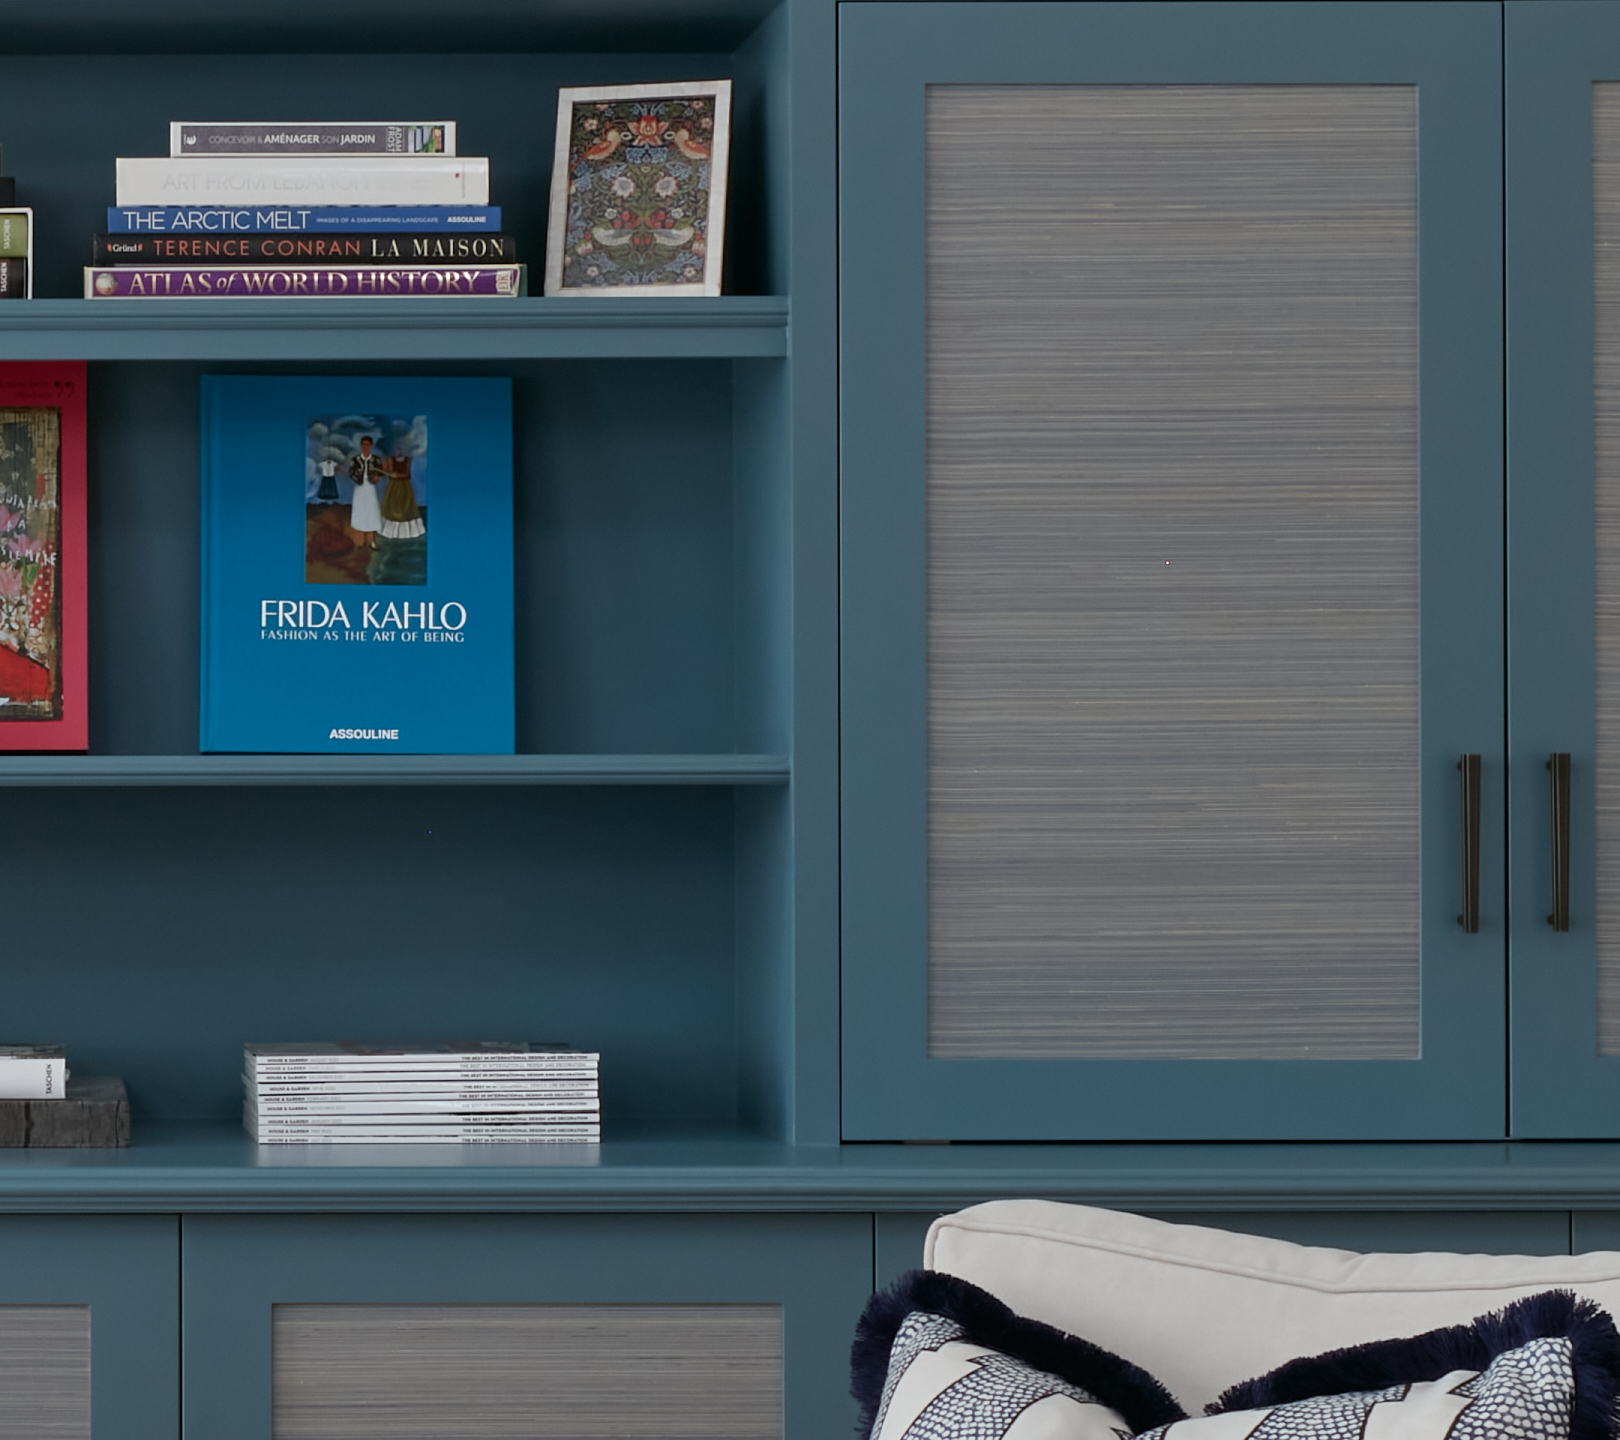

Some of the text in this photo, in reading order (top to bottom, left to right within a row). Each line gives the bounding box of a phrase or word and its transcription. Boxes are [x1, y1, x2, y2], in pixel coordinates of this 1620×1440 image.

[123, 211, 310, 230] THE ARCTIC MELT
[154, 239, 505, 257] TERENCE CONRAN LA MAISON
[129, 271, 482, 294] ATLAS of WORLD HISTORY
[261, 600, 466, 630] FRIDA KAHLO
[261, 630, 464, 643] FASHION AS THE ART OF BEING
[330, 729, 399, 740] ASSOULINE
